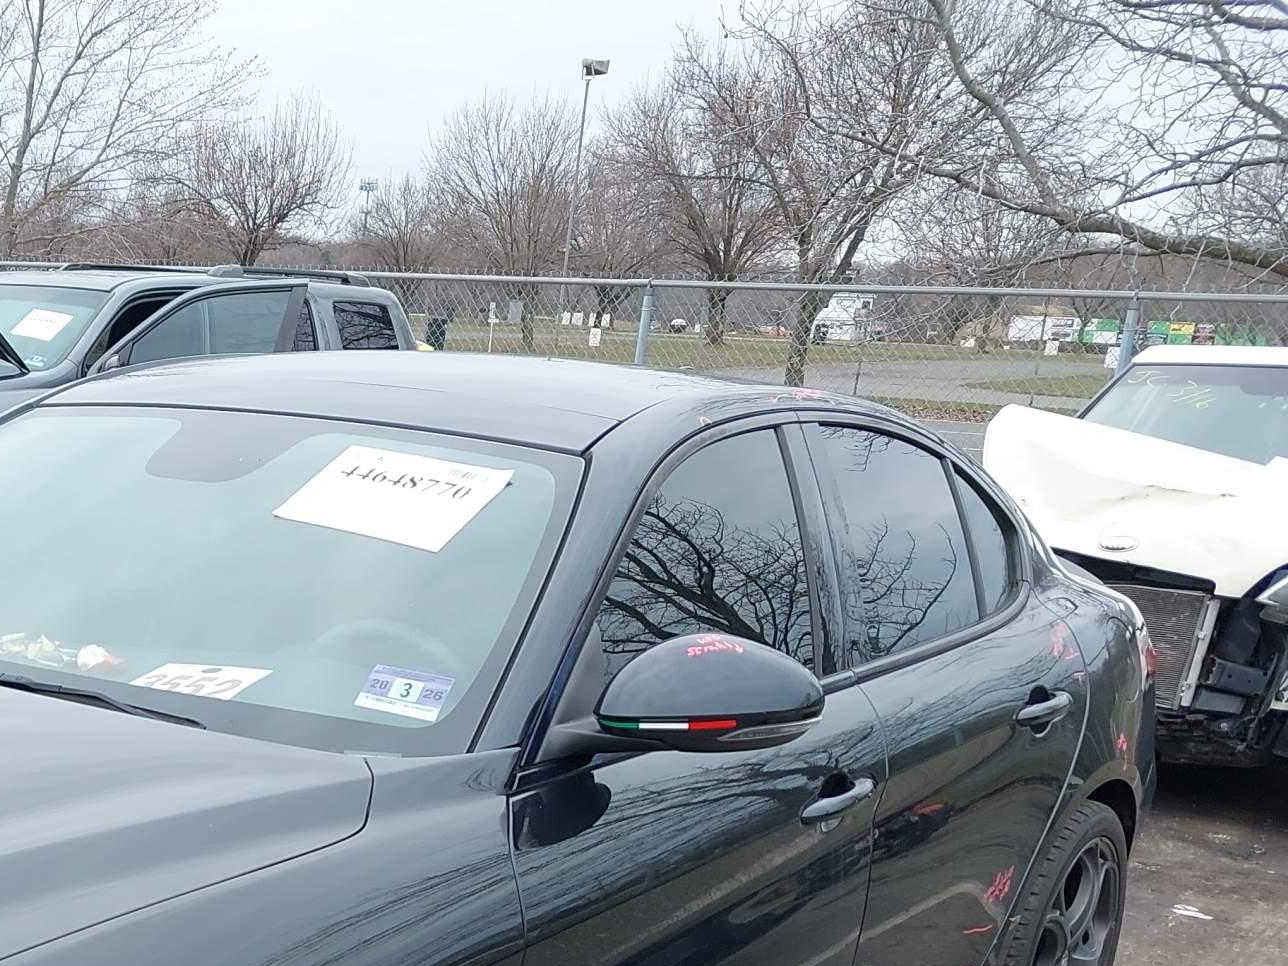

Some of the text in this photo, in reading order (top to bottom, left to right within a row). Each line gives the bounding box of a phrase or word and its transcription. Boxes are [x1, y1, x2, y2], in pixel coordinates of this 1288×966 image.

[340, 465, 473, 500] 44648770
[370, 678, 444, 701] 20 3 26
